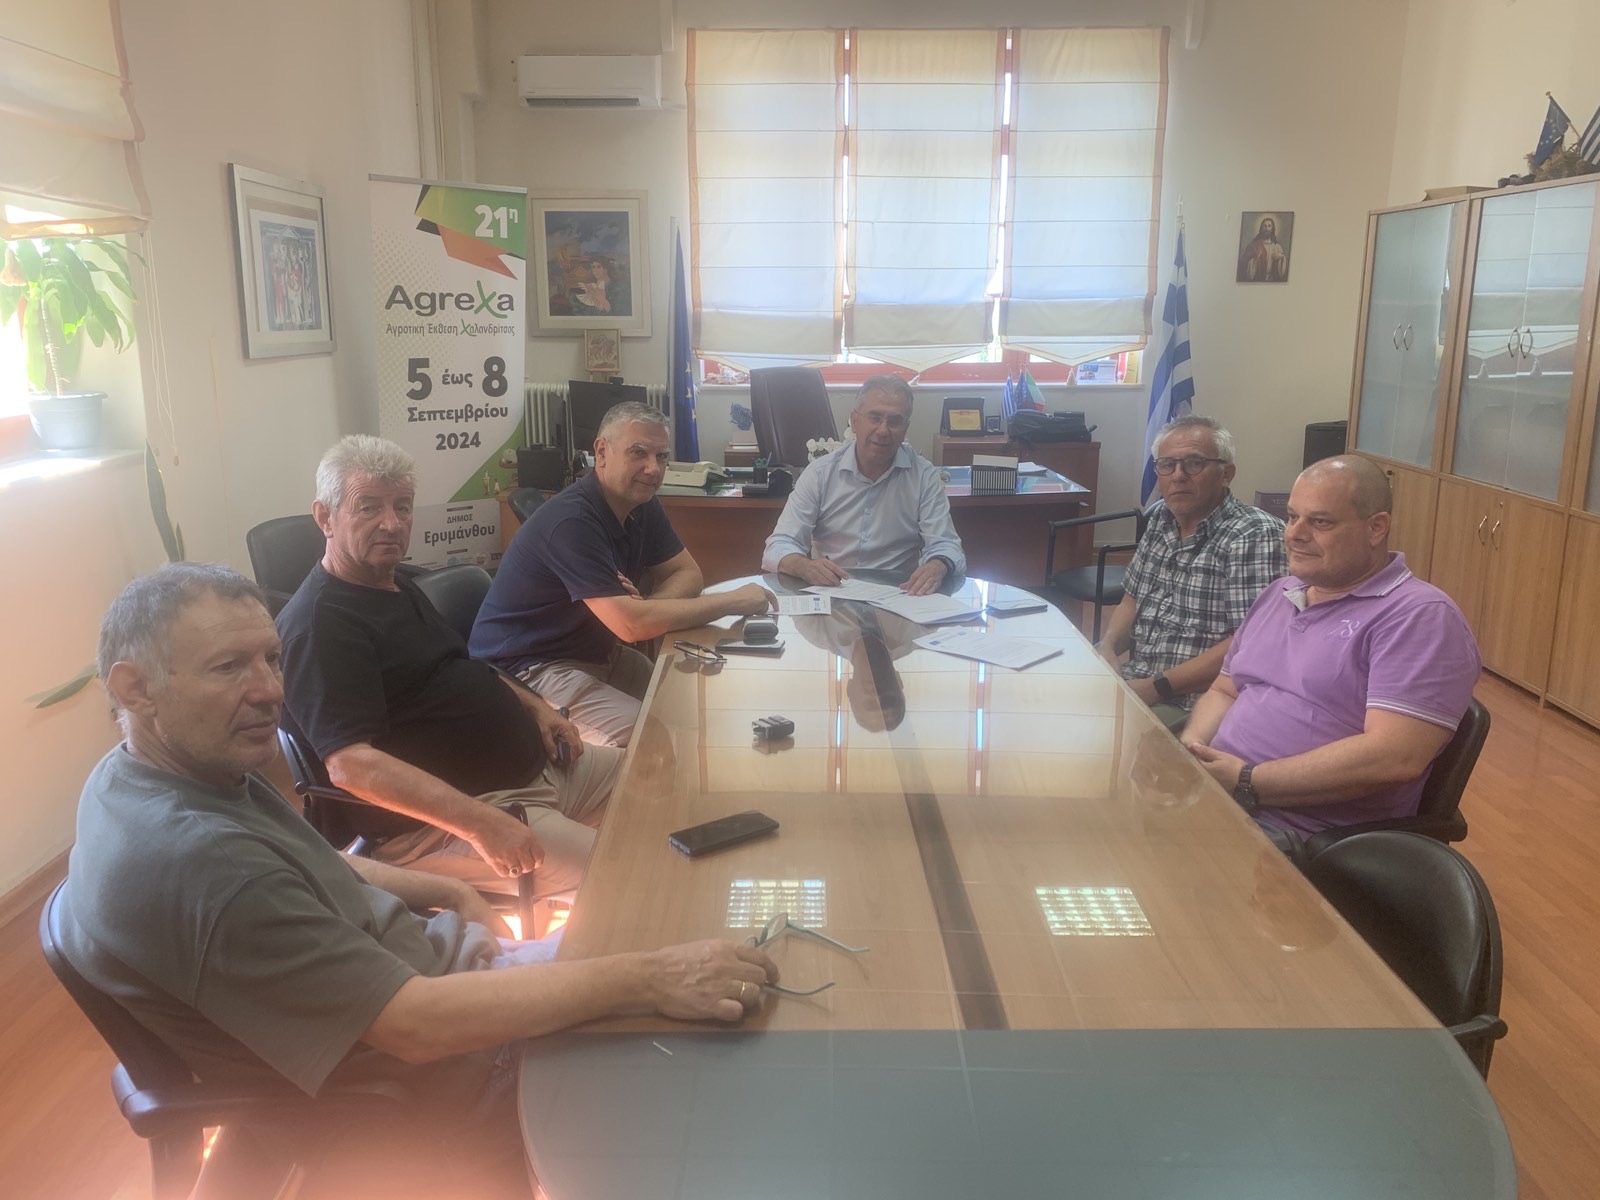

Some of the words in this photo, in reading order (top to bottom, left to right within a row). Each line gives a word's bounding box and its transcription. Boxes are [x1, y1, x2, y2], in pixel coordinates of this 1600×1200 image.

[406, 357, 433, 401] 5
[441, 368, 473, 388] έως
[481, 356, 508, 398] 8
[407, 402, 509, 423] Σεπτεμβρίου
[435, 431, 481, 451] 2024
[446, 513, 473, 525] ΔΗΜΟΣ
[424, 523, 495, 546] Ερυμάνθου
